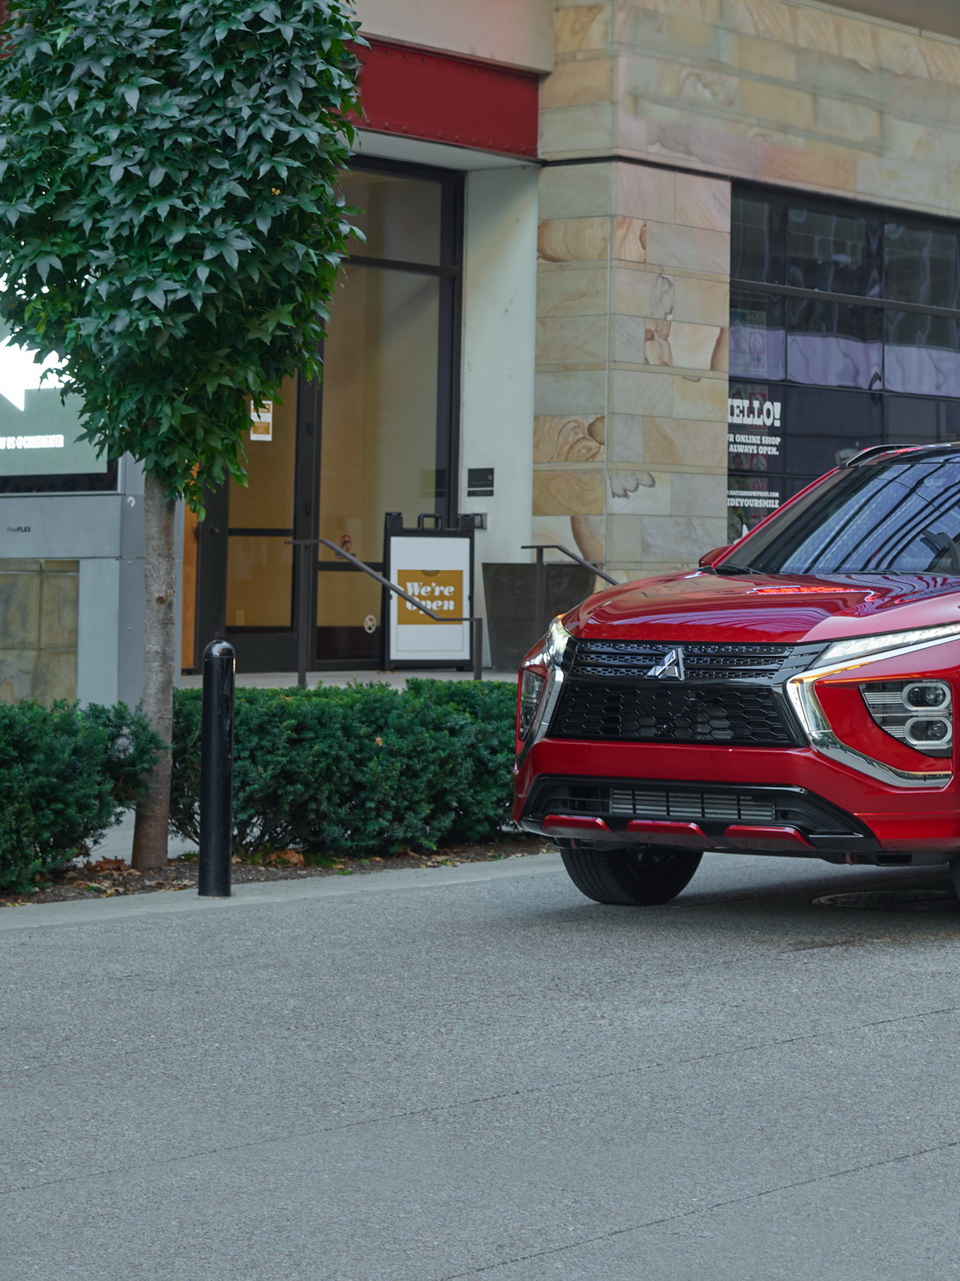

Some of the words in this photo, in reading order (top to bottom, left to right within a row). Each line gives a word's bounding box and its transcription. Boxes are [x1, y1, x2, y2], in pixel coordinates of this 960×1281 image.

[735, 434, 761, 444] ONLINE
[761, 436, 781, 446] SHOP
[729, 444, 758, 454] ALWAYS
[758, 445, 780, 456] OPEN.
[405, 582, 455, 596] We're
[405, 596, 455, 614] Open
